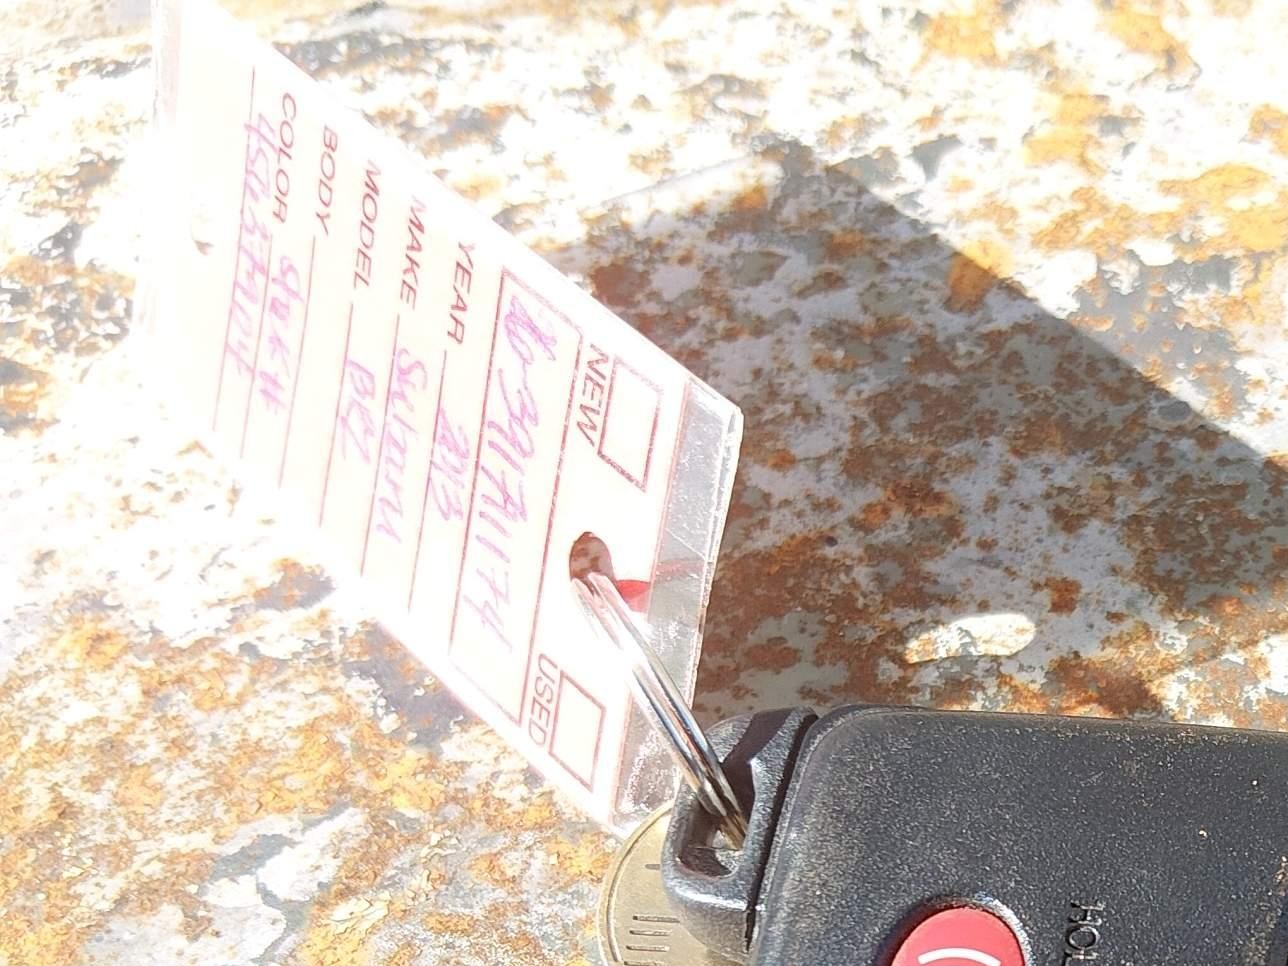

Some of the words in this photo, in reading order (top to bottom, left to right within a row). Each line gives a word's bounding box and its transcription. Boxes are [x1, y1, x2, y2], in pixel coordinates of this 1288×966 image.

[272, 91, 297, 225] COLOR
[314, 122, 338, 236] BODY
[351, 159, 383, 290] MODEL
[400, 194, 427, 311] MAKE
[447, 240, 476, 344] YEAR
[576, 343, 610, 448] NEW
[528, 653, 558, 748] USED
